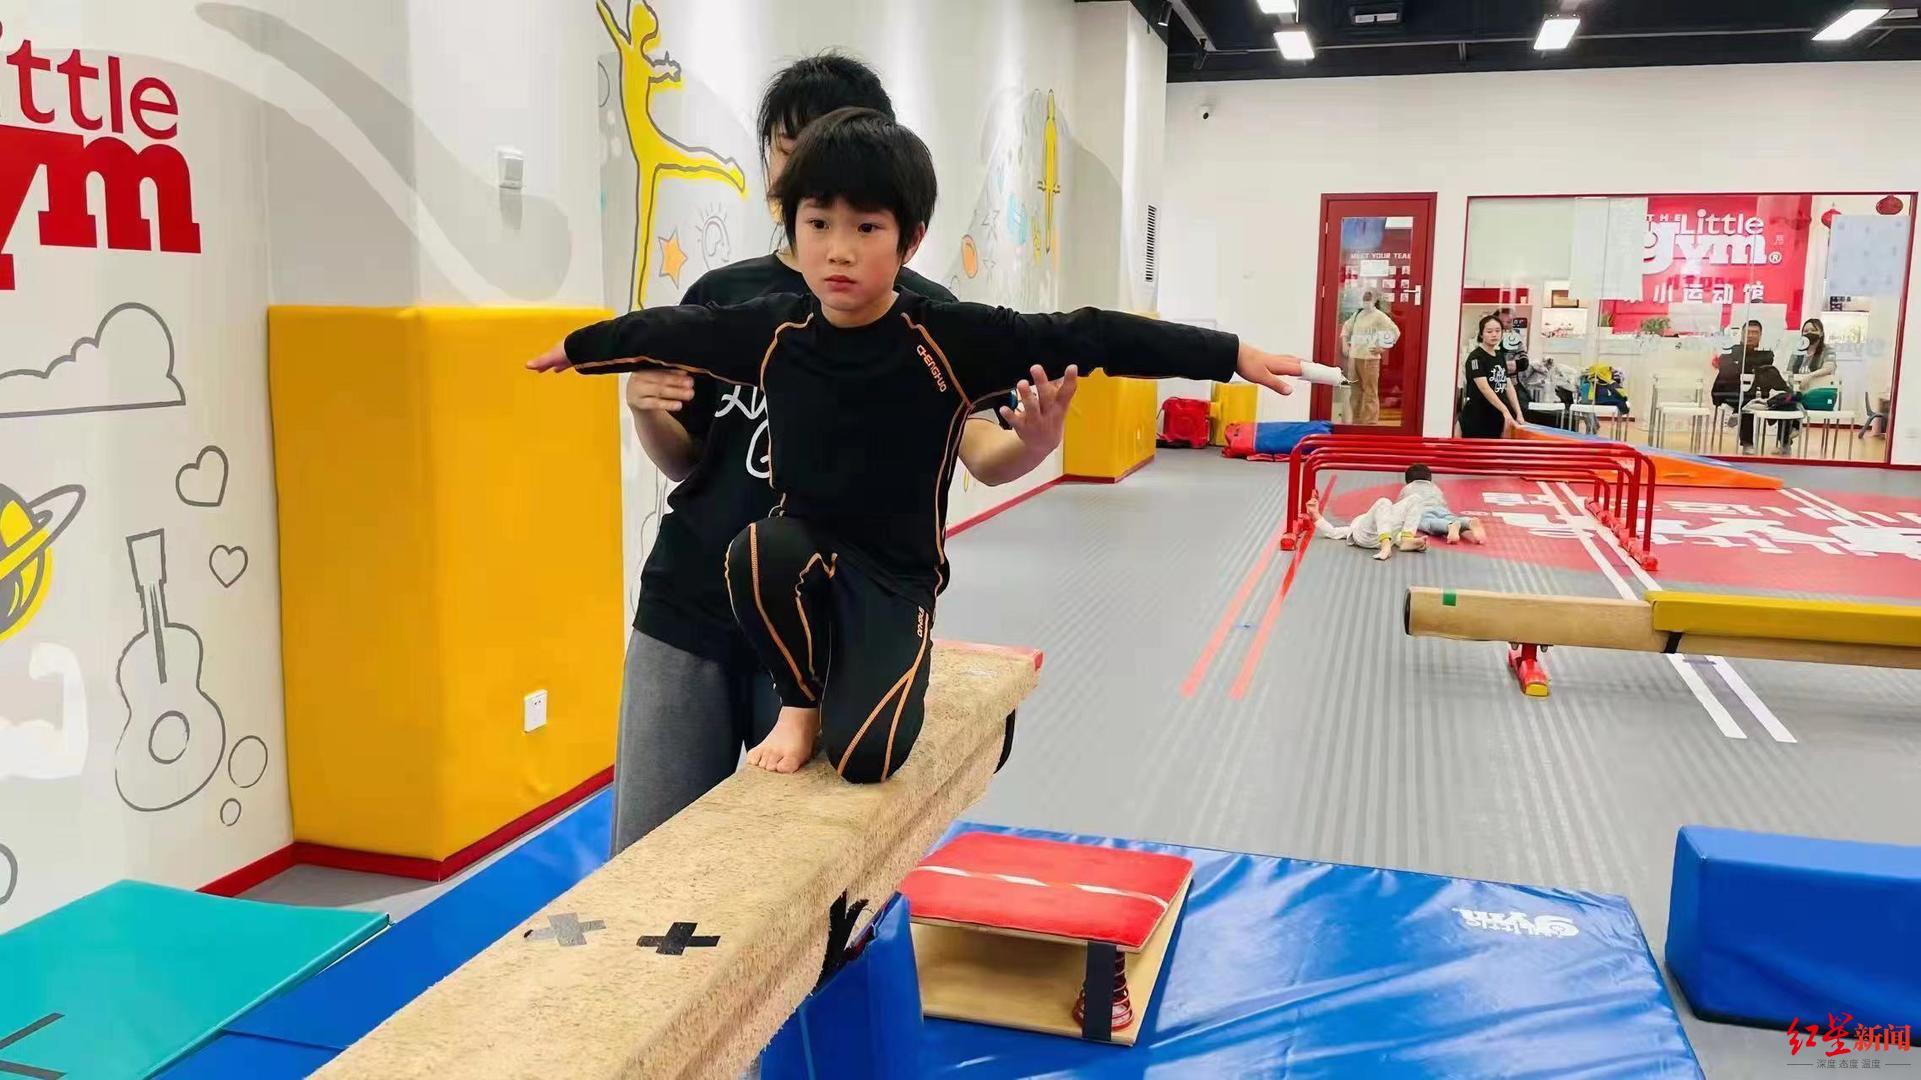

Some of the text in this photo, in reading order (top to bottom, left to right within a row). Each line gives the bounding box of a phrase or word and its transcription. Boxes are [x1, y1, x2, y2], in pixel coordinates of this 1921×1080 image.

[0, 22, 178, 140] ttle
[1680, 208, 1764, 235] Little
[1625, 282, 1764, 304] 小运动馆
